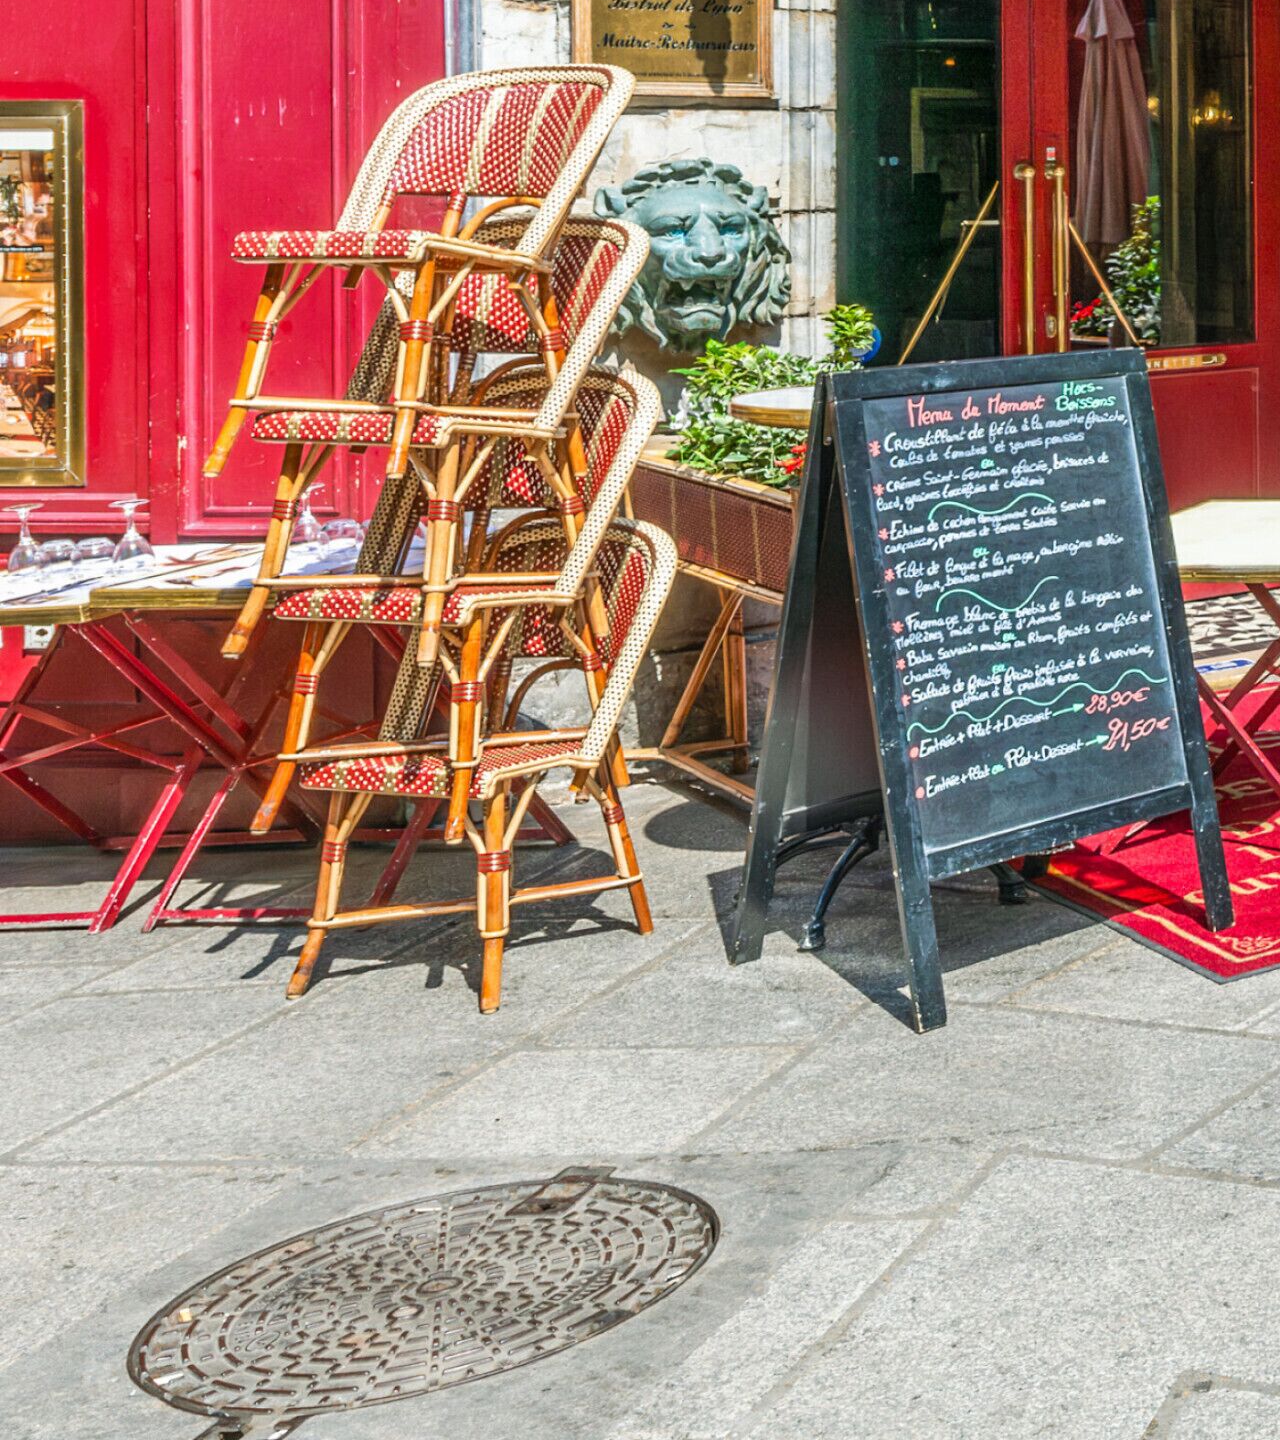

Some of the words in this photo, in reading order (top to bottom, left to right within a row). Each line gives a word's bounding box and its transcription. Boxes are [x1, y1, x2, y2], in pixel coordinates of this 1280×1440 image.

[1146, 358, 1195, 368] NNETTE
[907, 395, 954, 428] Menu
[961, 396, 981, 419] du
[988, 393, 1046, 416] Moment
[1054, 394, 1116, 411] Boissons
[967, 424, 984, 441] de
[1031, 416, 1043, 431] la
[926, 450, 938, 462] de
[994, 441, 1005, 454] et
[927, 561, 940, 576] de
